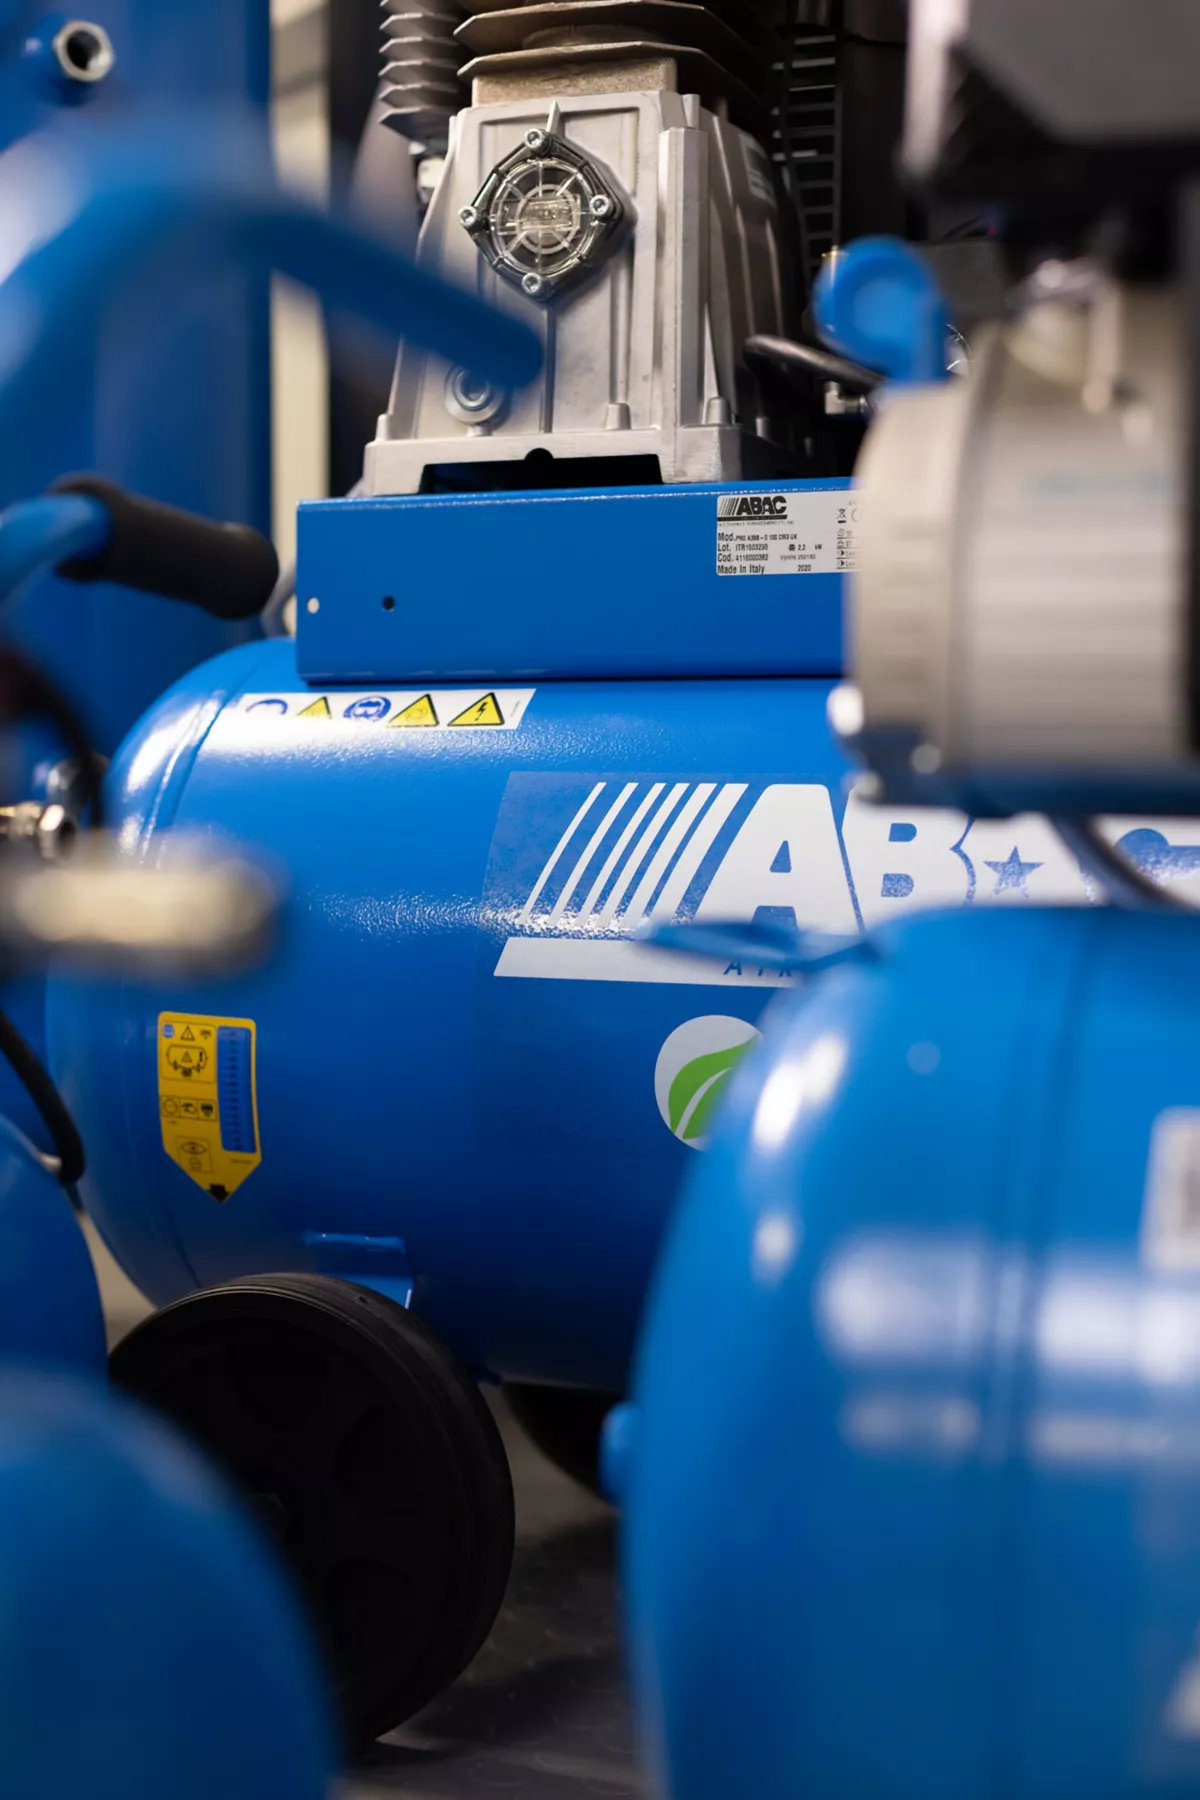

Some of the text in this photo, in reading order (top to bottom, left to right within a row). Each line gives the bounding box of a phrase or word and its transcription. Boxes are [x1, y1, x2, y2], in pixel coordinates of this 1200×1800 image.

[736, 495, 787, 515] ABAC
[717, 532, 736, 541] Mod.
[717, 543, 731, 552] Lot.
[717, 553, 734, 562] Cod.
[717, 564, 737, 574] Made
[749, 564, 766, 575] Italy
[797, 564, 812, 572] 2020
